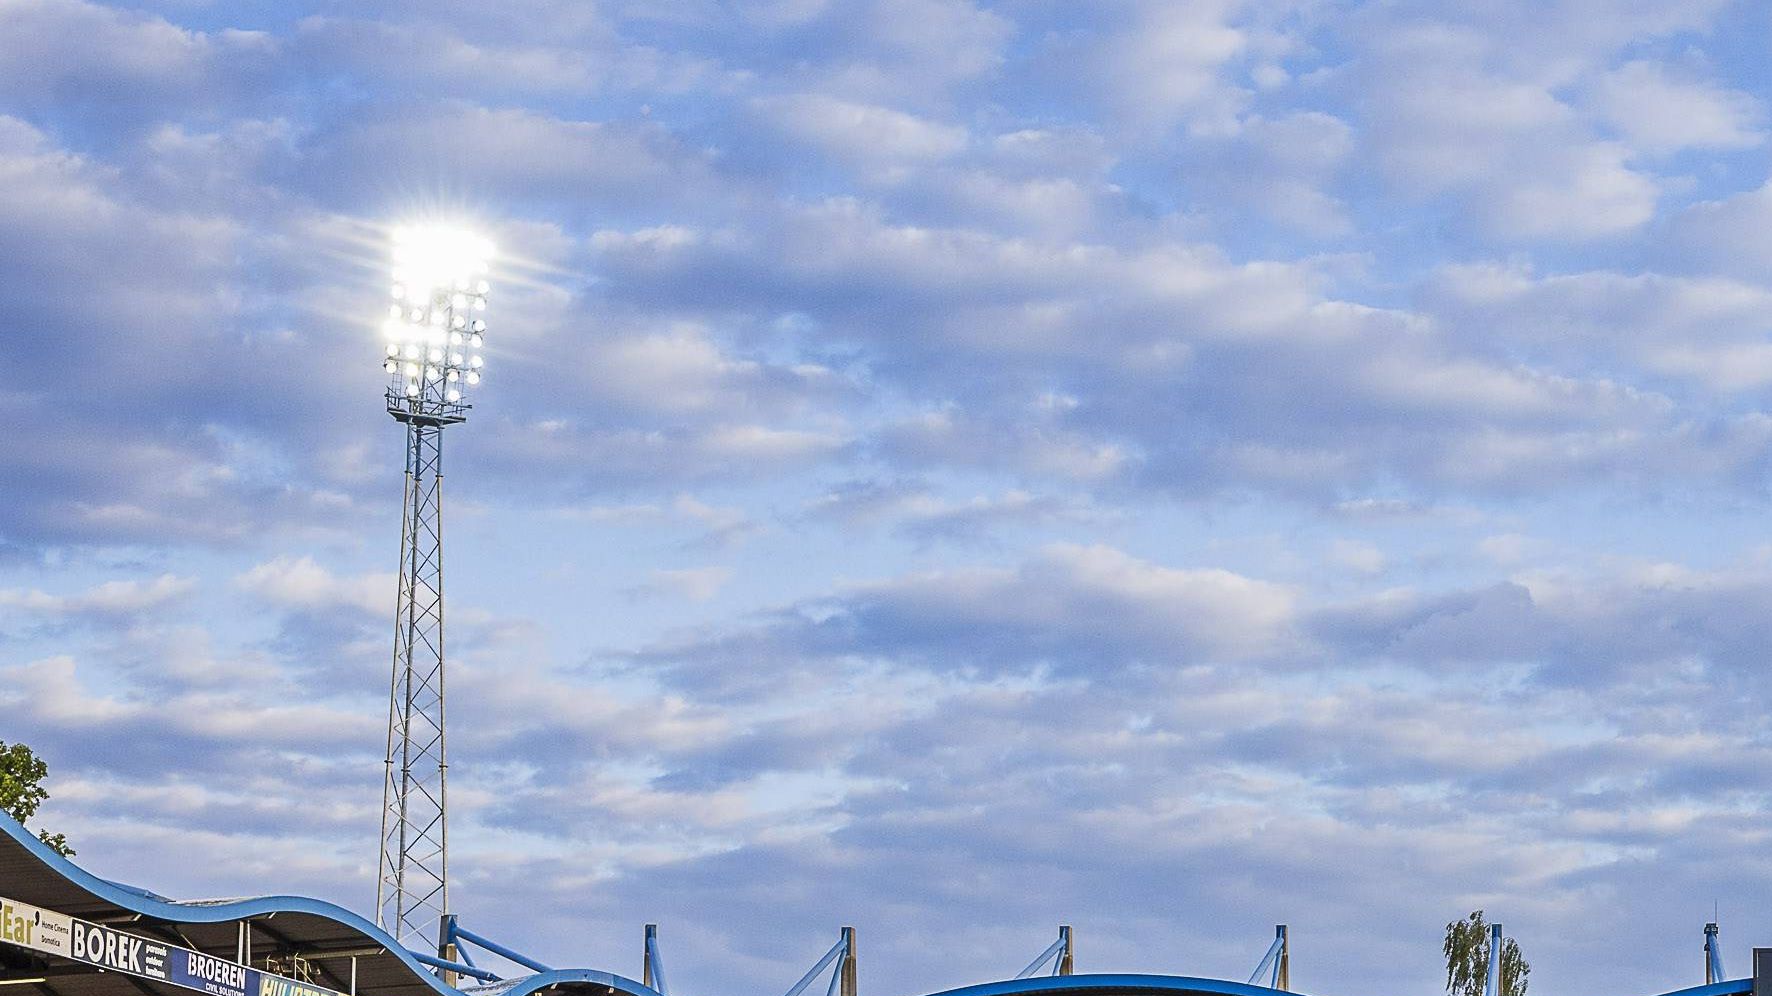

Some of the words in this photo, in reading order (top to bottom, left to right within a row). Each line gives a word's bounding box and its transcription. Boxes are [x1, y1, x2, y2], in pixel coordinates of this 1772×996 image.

[74, 923, 142, 973] BOREK
[187, 952, 246, 990] BROEREN
[205, 982, 218, 994] CIVIL
